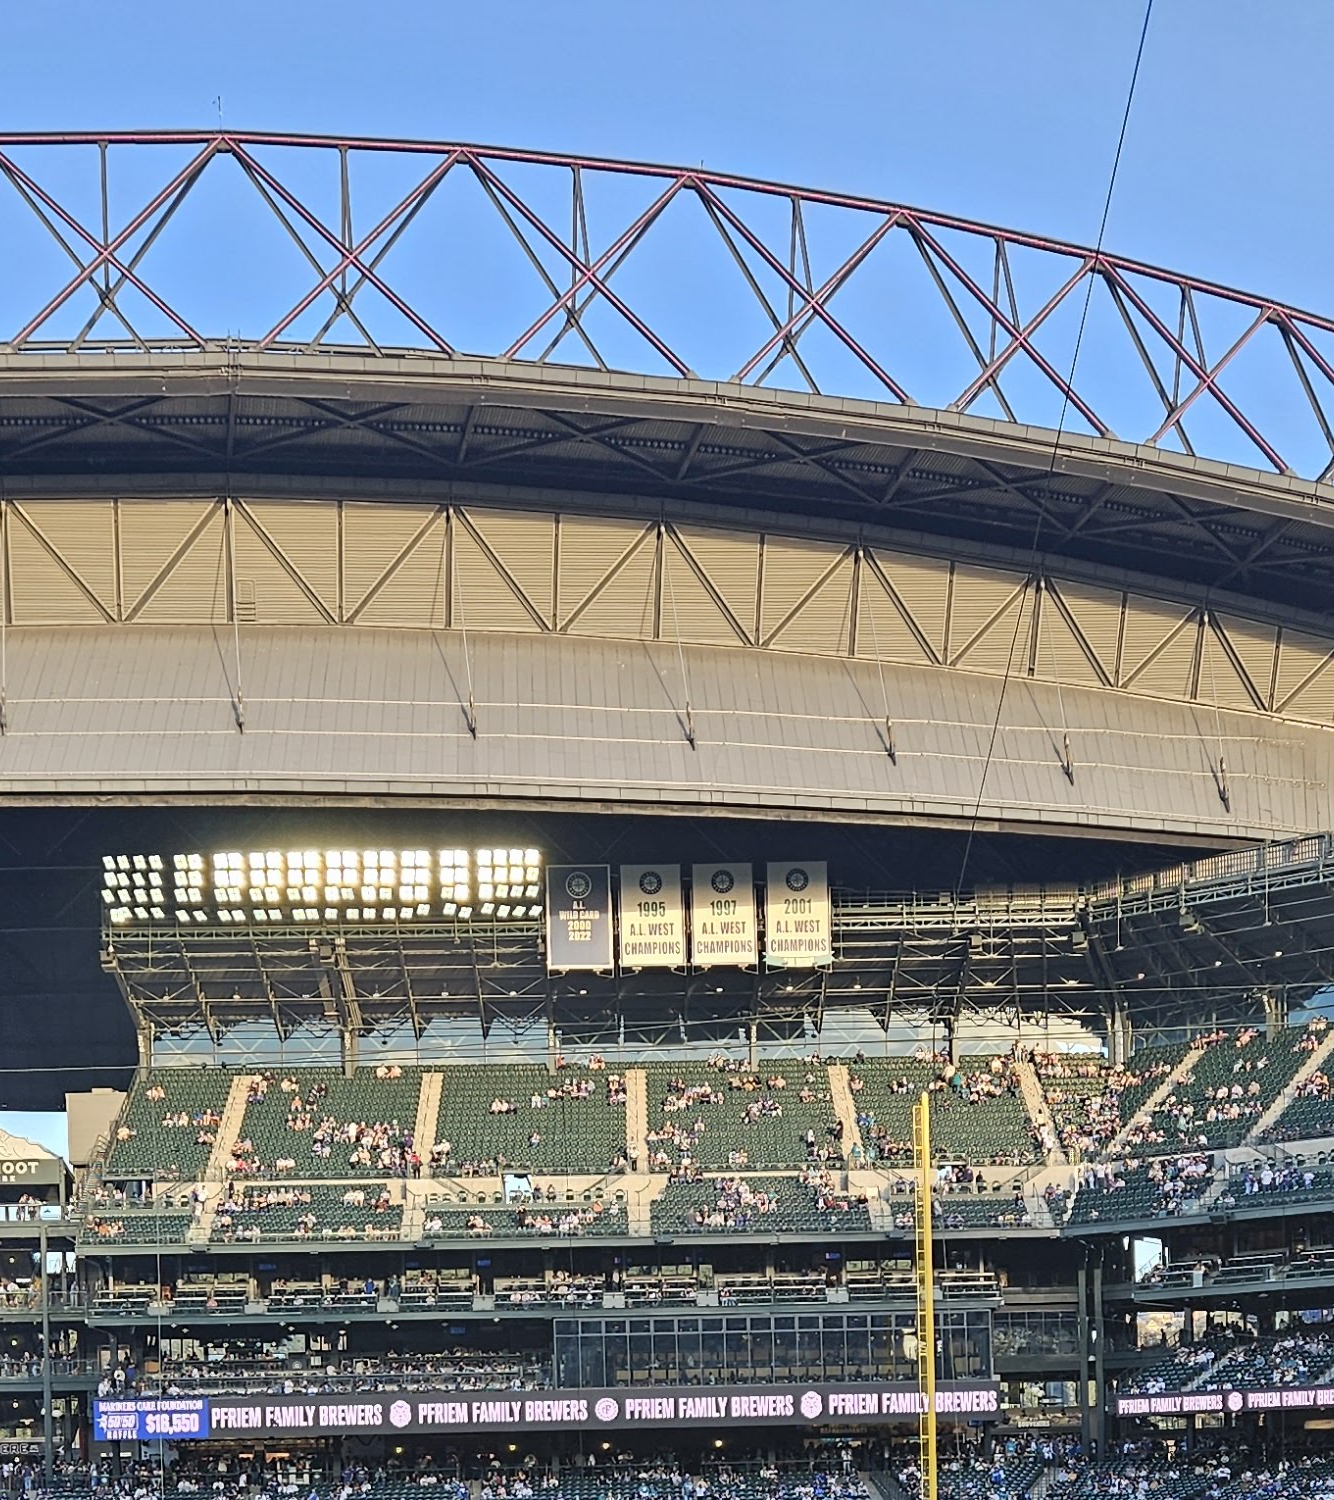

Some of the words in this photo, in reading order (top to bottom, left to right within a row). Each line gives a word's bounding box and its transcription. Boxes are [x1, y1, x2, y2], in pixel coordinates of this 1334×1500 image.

[637, 901, 666, 917] 1995
[709, 900, 737, 917] 1997
[783, 898, 812, 915] 2001
[567, 920, 592, 931] 2000
[630, 923, 646, 936] A.L.
[648, 922, 674, 936] WEST
[701, 922, 719, 935] A.L.
[720, 921, 746, 934] WEST
[776, 920, 793, 934] A.L.
[795, 920, 820, 933] WEST
[568, 931, 592, 941] 2022
[624, 941, 681, 955] CHAMPIONS
[696, 939, 753, 954] CHAMPIONS
[770, 938, 827, 953] CHAMPIONS
[211, 1406, 262, 1429] PFRIEM
[265, 1405, 316, 1428] FAMILY
[319, 1404, 382, 1427] BREWERS
[418, 1402, 468, 1425] PFRIEM
[472, 1401, 521, 1424] FAMILY
[525, 1400, 589, 1422] BREWERS
